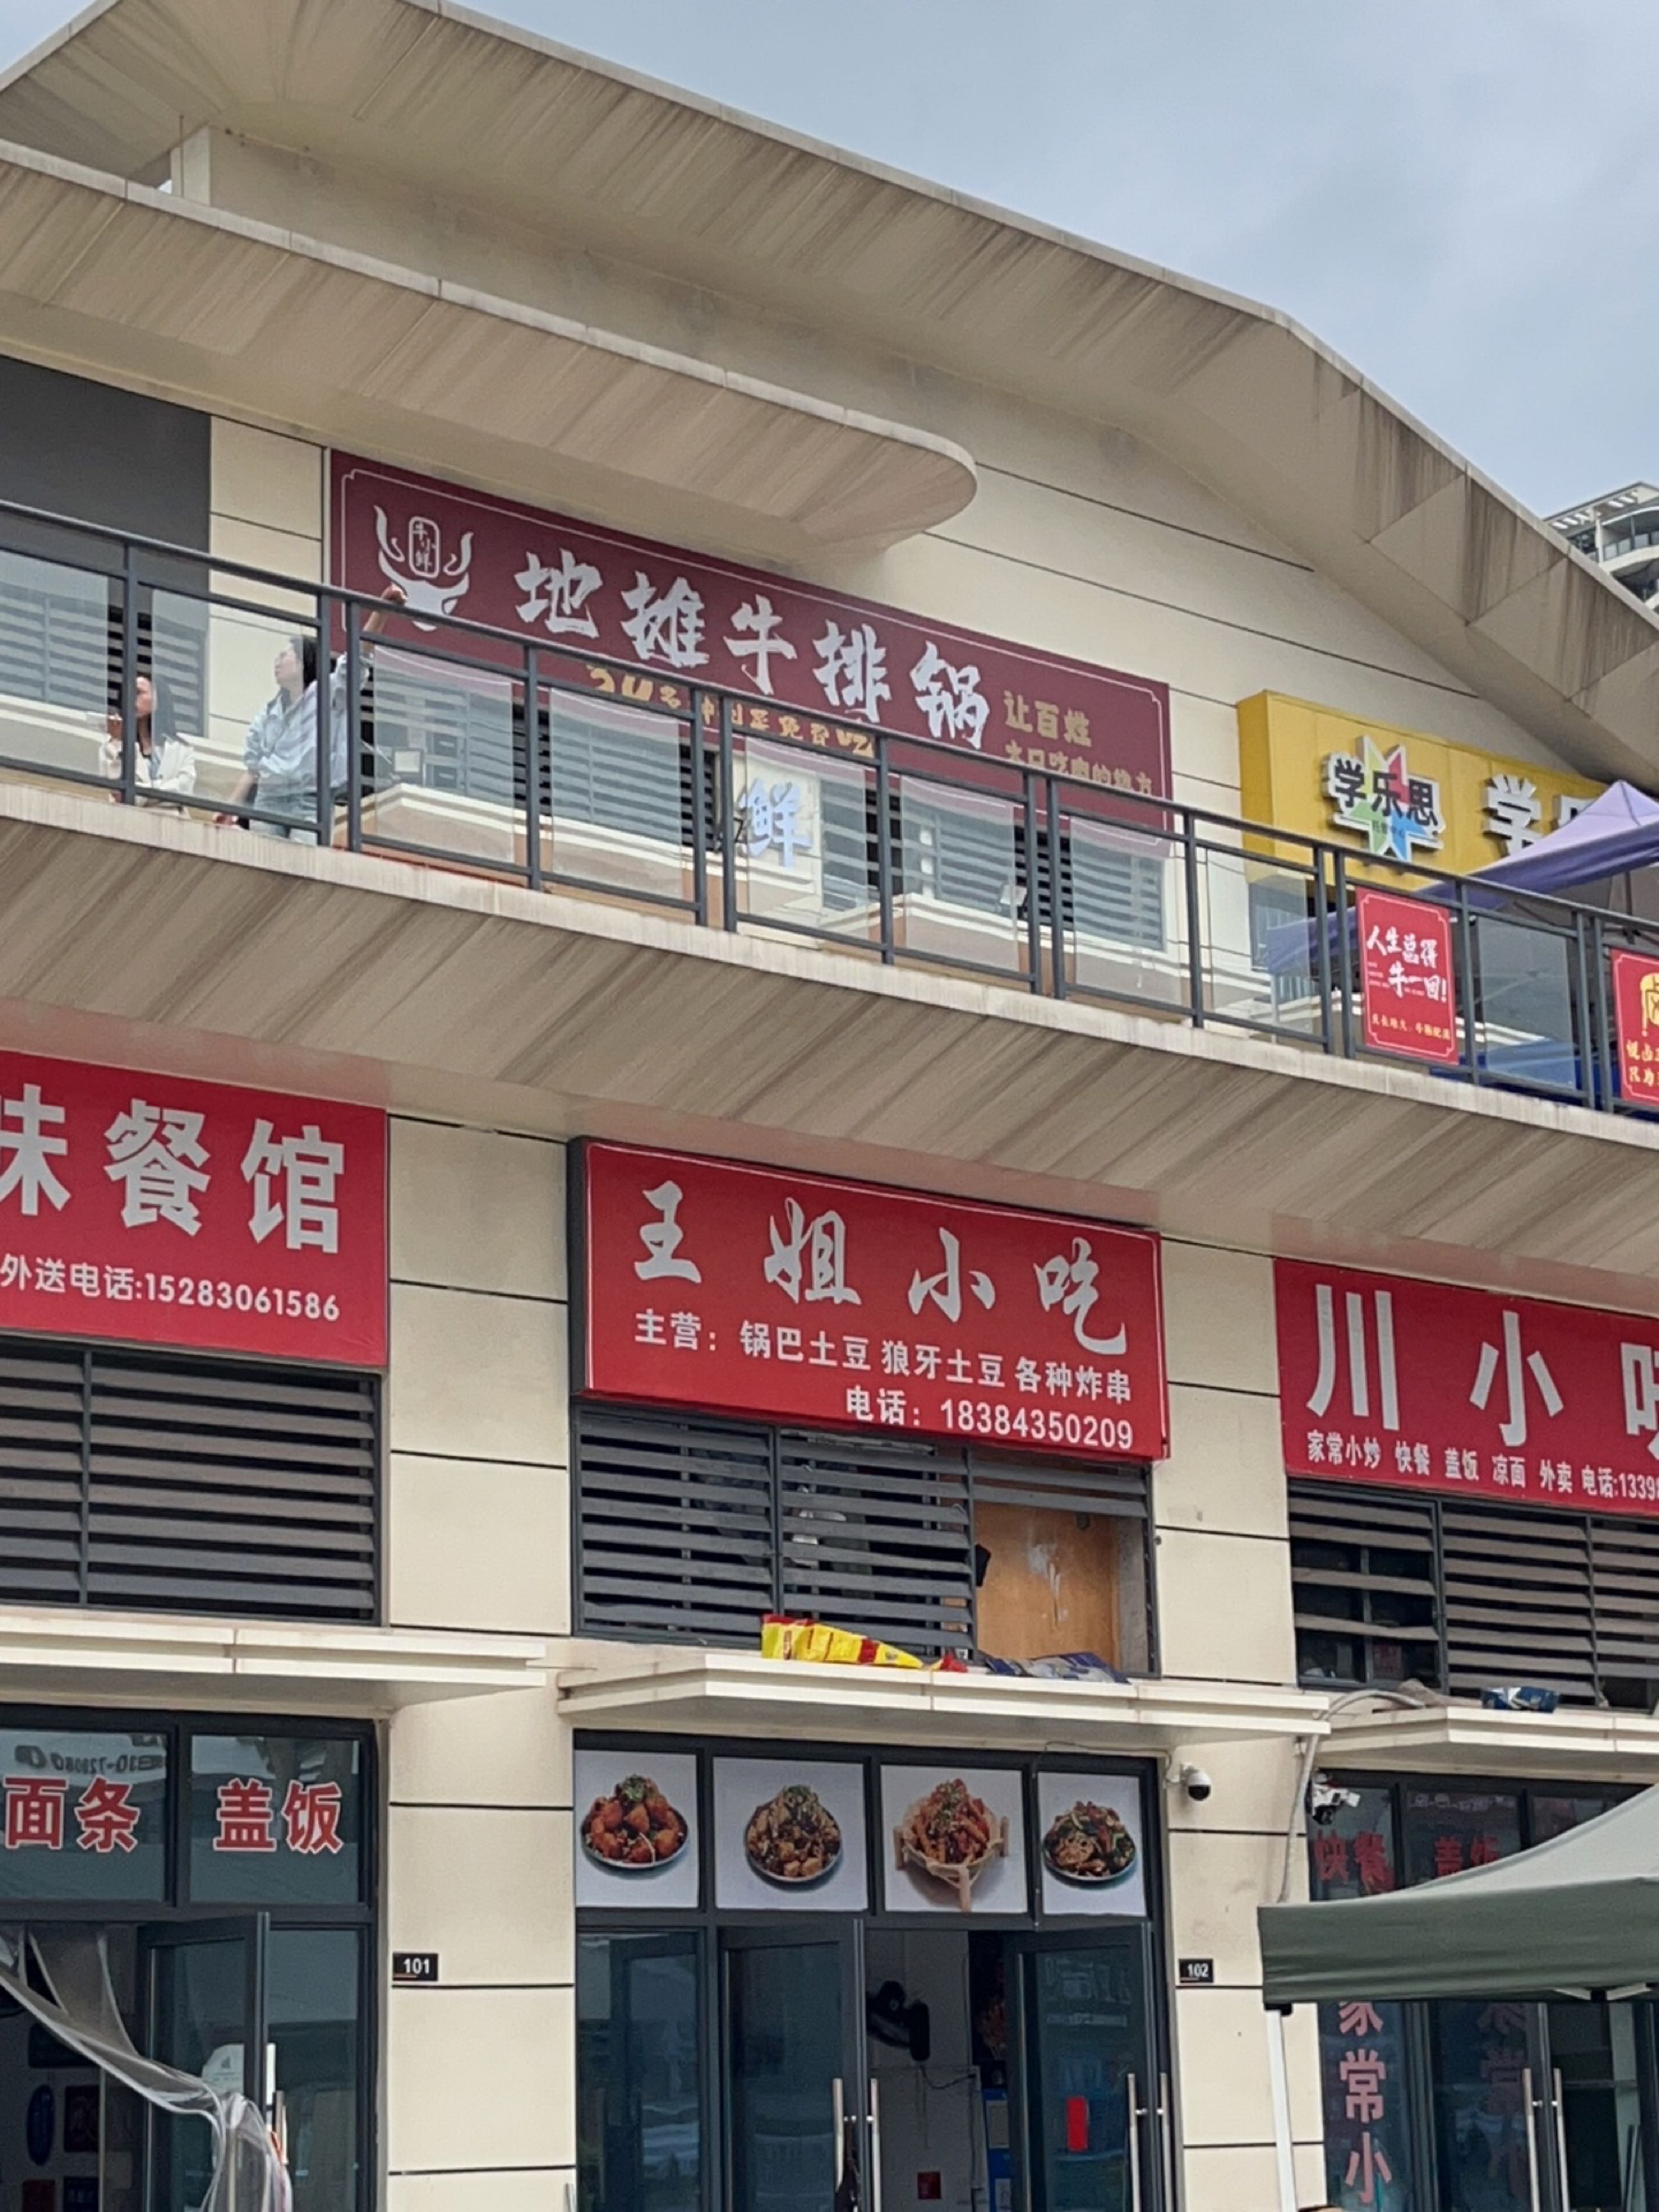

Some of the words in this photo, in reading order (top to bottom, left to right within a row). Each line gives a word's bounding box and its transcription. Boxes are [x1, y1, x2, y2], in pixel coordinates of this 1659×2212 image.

[515, 549, 990, 749] 地摊牛排锅
[1004, 690, 1091, 748] 让百姓
[736, 778, 812, 867] 鲜
[1334, 758, 1438, 826] 学乐思
[0, 1253, 339, 1320] 外送电话:15283061586
[634, 1180, 1126, 1355] 王姐小吃
[3, 1776, 140, 1853] 面条
[212, 1779, 343, 1854] 盖饭
[1314, 1829, 1394, 1893] 快餐
[403, 1958, 431, 1975] 101
[1187, 1963, 1209, 1978] 102
